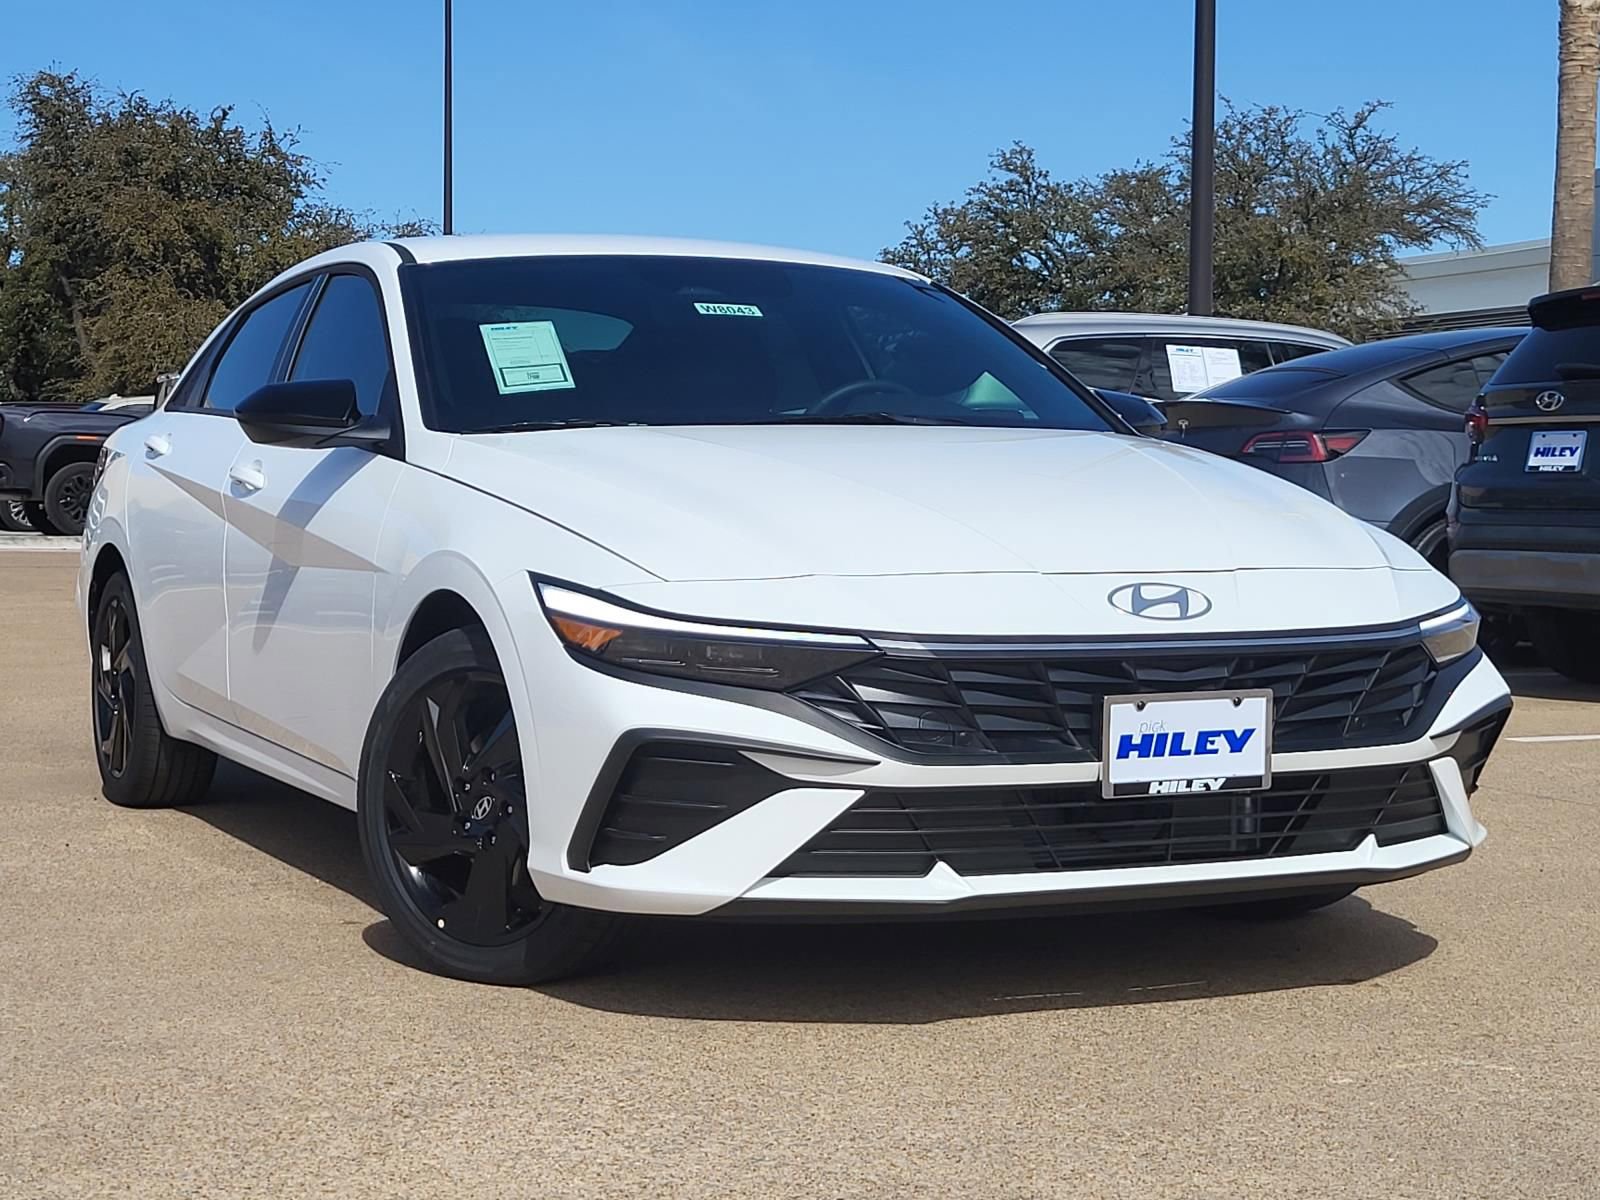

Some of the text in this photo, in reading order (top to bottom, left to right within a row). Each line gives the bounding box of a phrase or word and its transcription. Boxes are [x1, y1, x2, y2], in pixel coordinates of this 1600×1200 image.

[699, 304, 757, 315] W8043
[1533, 446, 1580, 458] HILEY
[1139, 720, 1167, 734] pick
[1116, 728, 1257, 760] HILEY
[1148, 778, 1227, 795] HILEY
